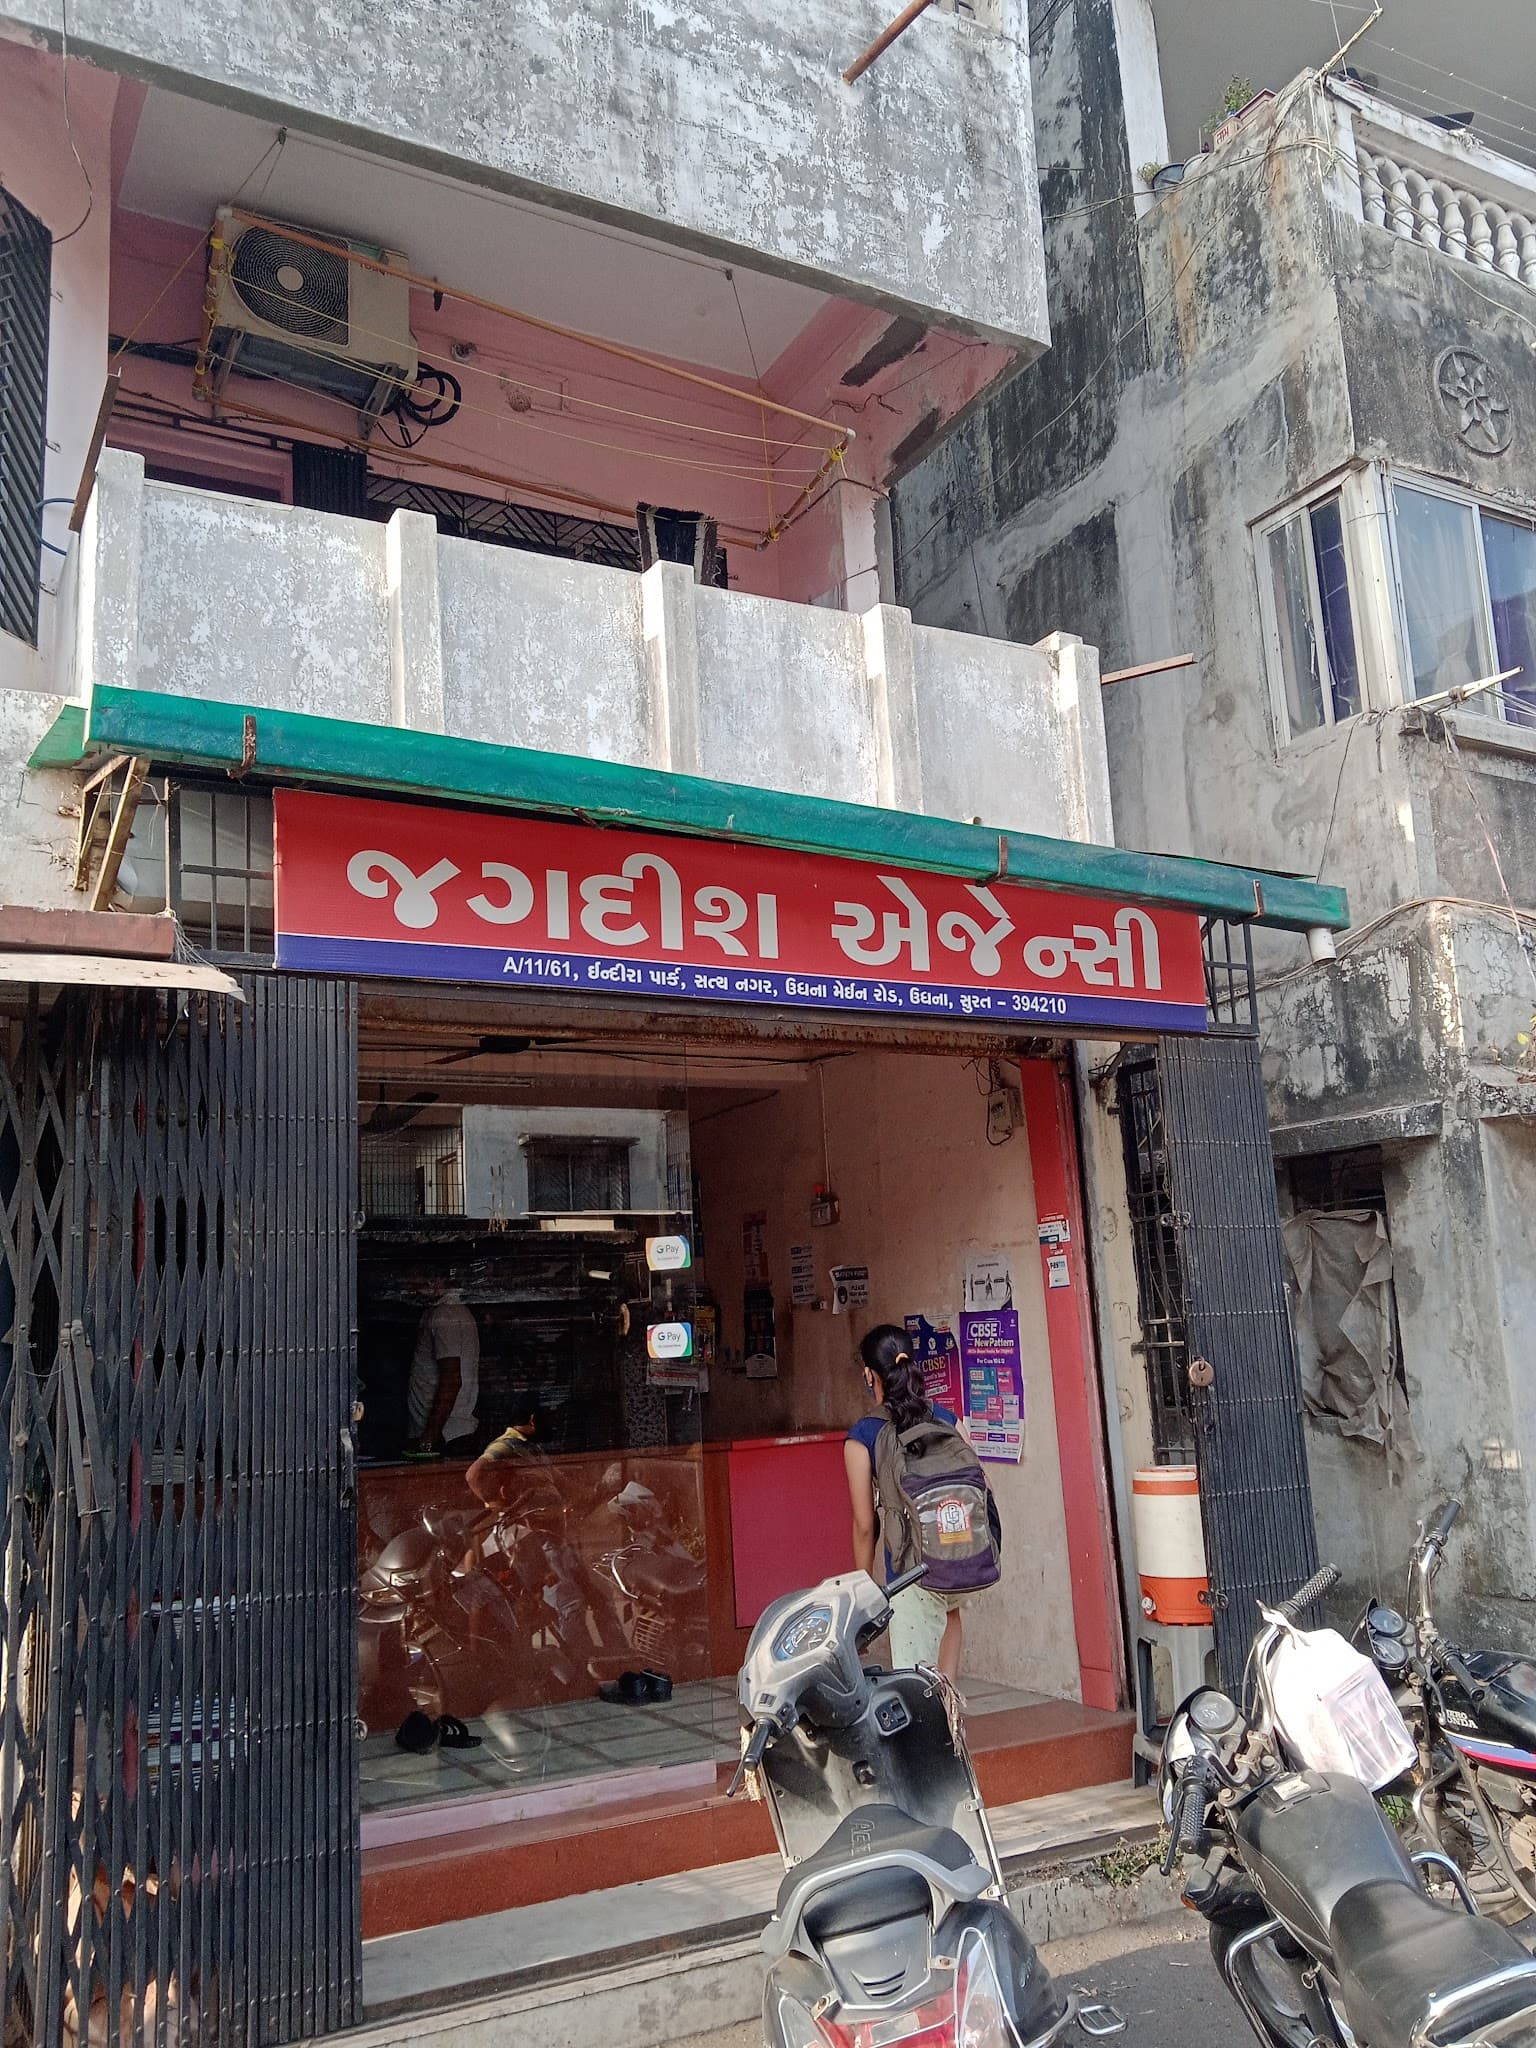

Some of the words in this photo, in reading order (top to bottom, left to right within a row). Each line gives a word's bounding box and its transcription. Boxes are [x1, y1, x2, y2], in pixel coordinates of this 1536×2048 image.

[346, 849, 779, 960] જગદીશ
[831, 875, 1162, 991] એજેન્સી
[503, 956, 579, 982] A/11/61,
[588, 961, 642, 984] ઈન્દીરા
[649, 967, 686, 990] પાર્ક,
[735, 978, 778, 998] નગર,
[873, 984, 903, 1006] રોડ,
[959, 994, 992, 1013] સુરત
[1012, 995, 1066, 1014] 394210
[665, 1244, 680, 1255] Pay
[657, 1332, 665, 1341] G
[667, 1331, 682, 1342] Pay
[970, 1322, 998, 1337] CBSE
[922, 1356, 946, 1373] CBSE
